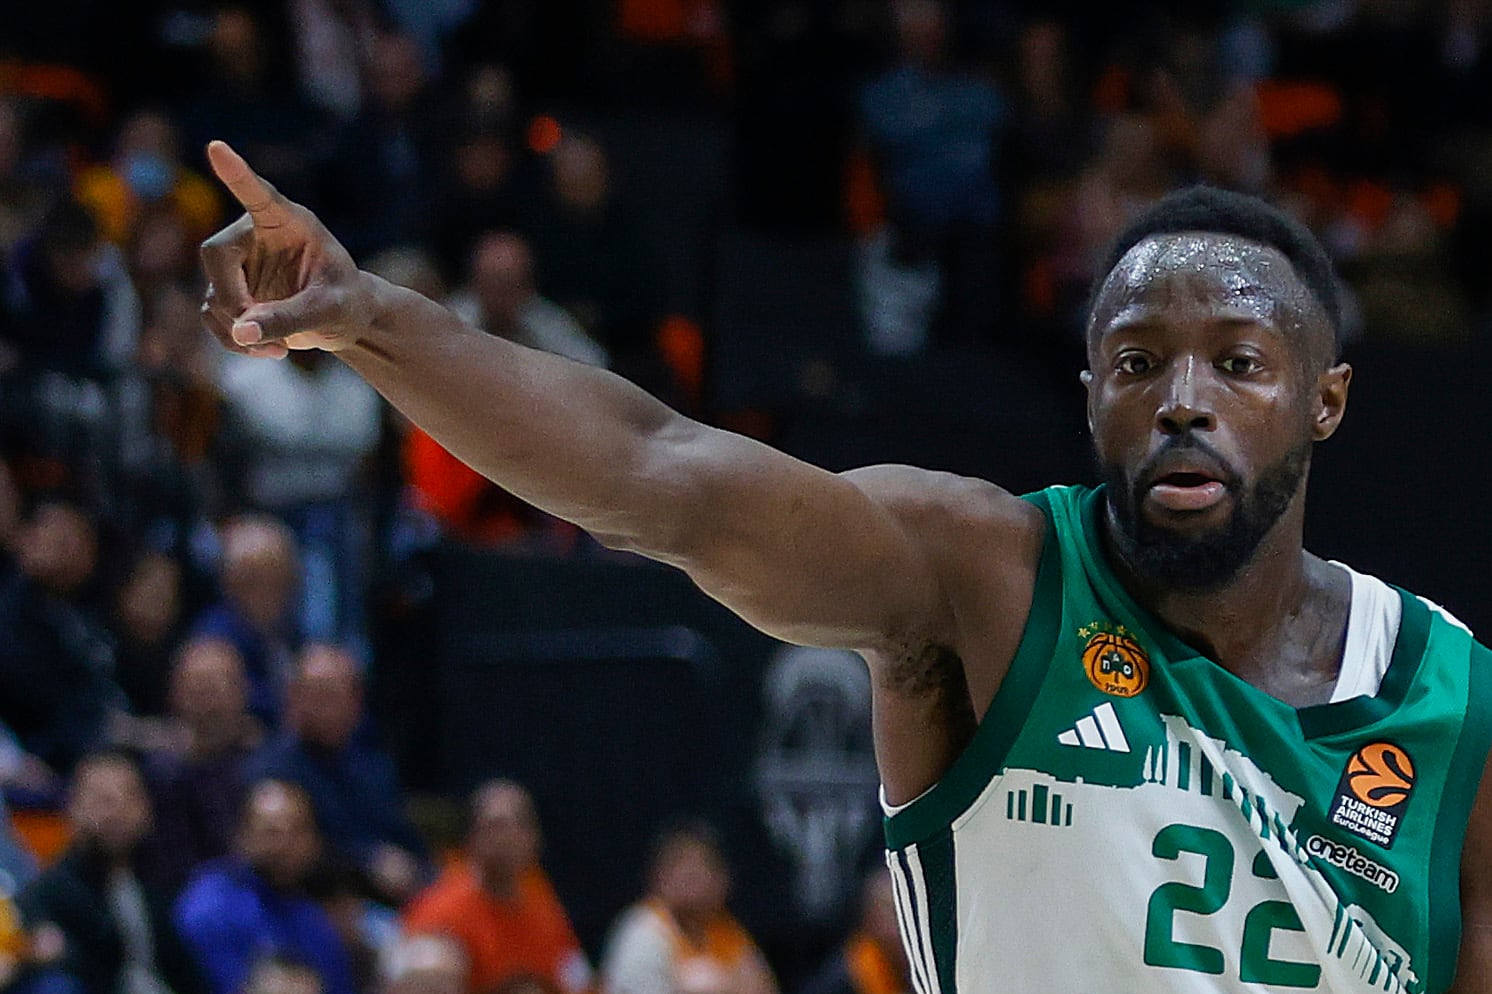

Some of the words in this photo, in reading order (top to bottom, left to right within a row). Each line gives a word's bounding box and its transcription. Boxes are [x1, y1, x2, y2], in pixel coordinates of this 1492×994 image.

[1336, 806, 1393, 837] AIRLINES
[1341, 795, 1398, 827] TURKISH
[1333, 814, 1390, 845] EuroLeague
[1307, 836, 1398, 892] oneteam
[1144, 823, 1322, 989] 22
